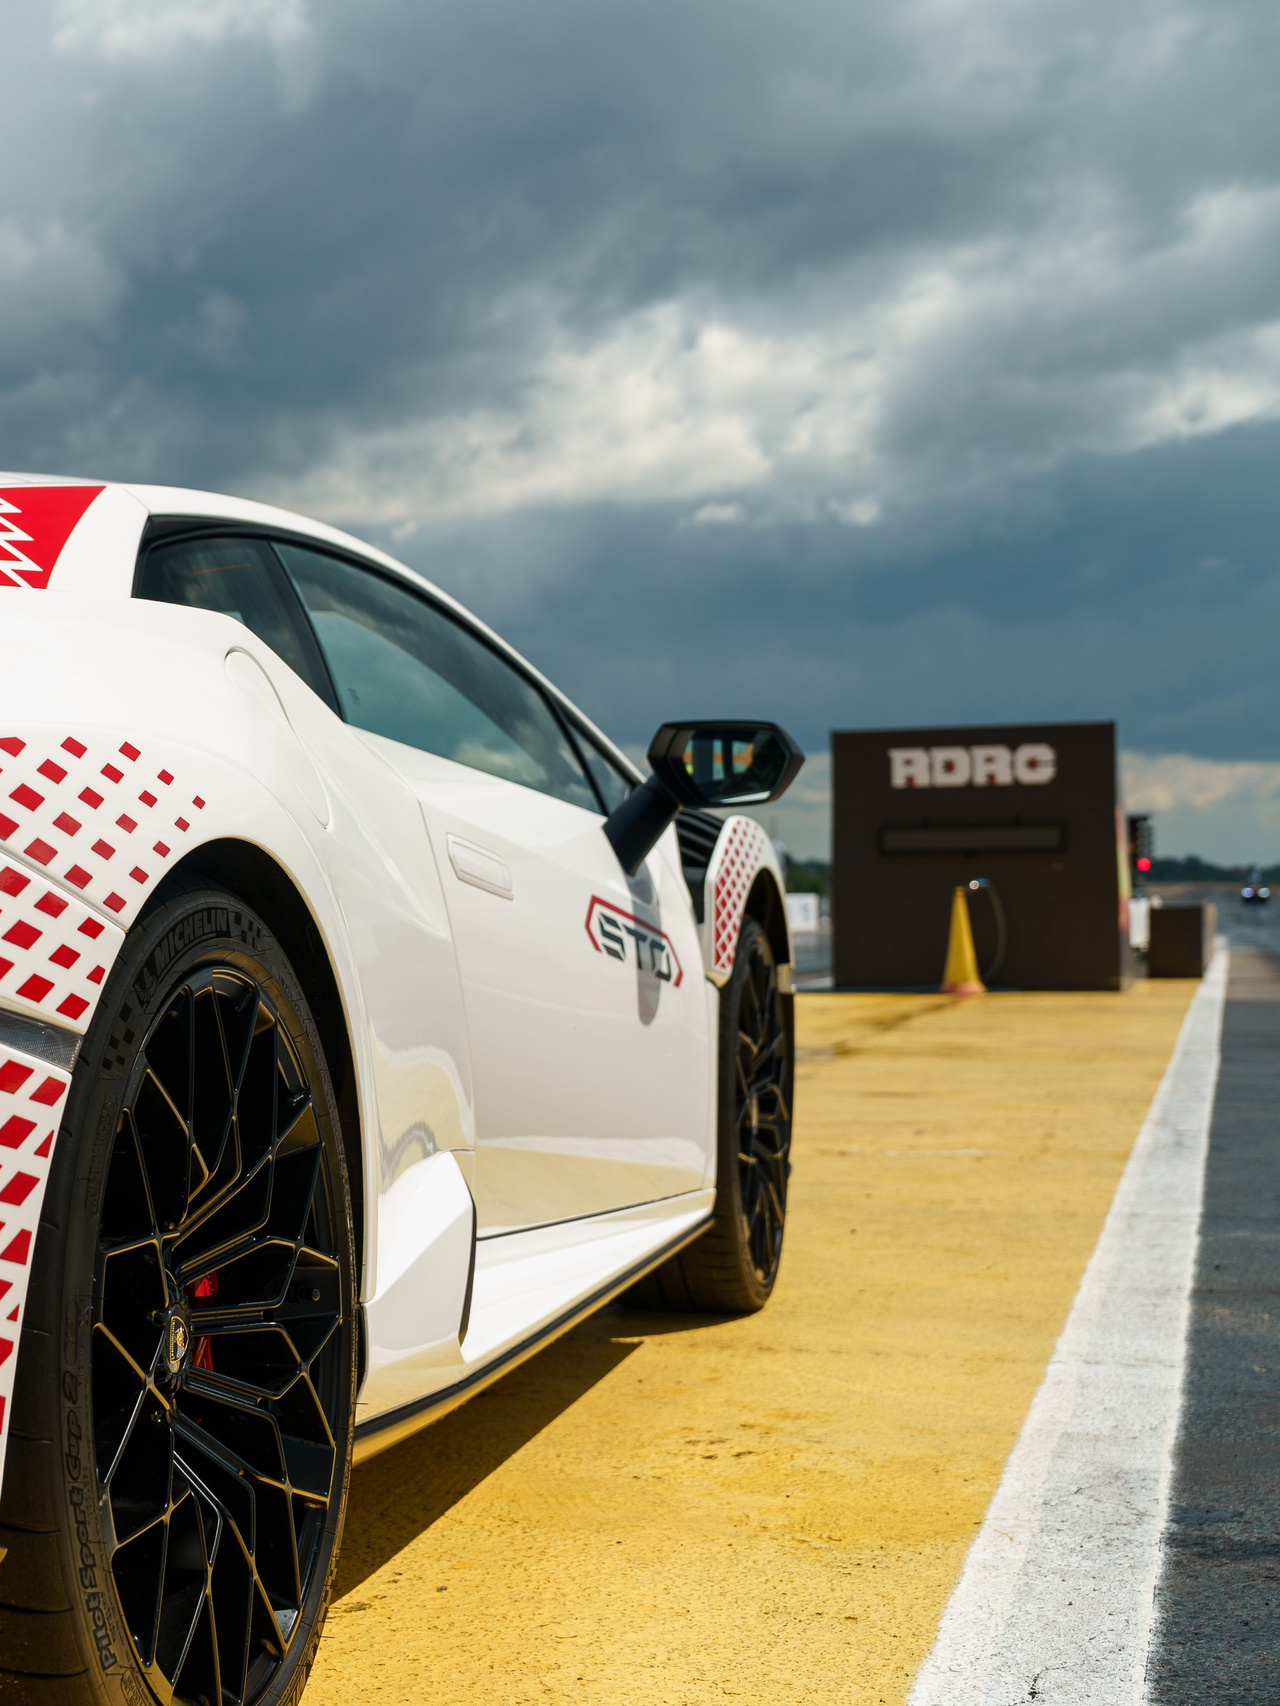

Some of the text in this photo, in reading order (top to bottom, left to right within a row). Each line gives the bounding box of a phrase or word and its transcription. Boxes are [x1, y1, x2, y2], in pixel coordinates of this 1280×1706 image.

[887, 743, 1056, 789] RDRC
[154, 908, 228, 976] MICHELIN
[598, 911, 672, 982] STO
[62, 1370, 77, 1405] 2
